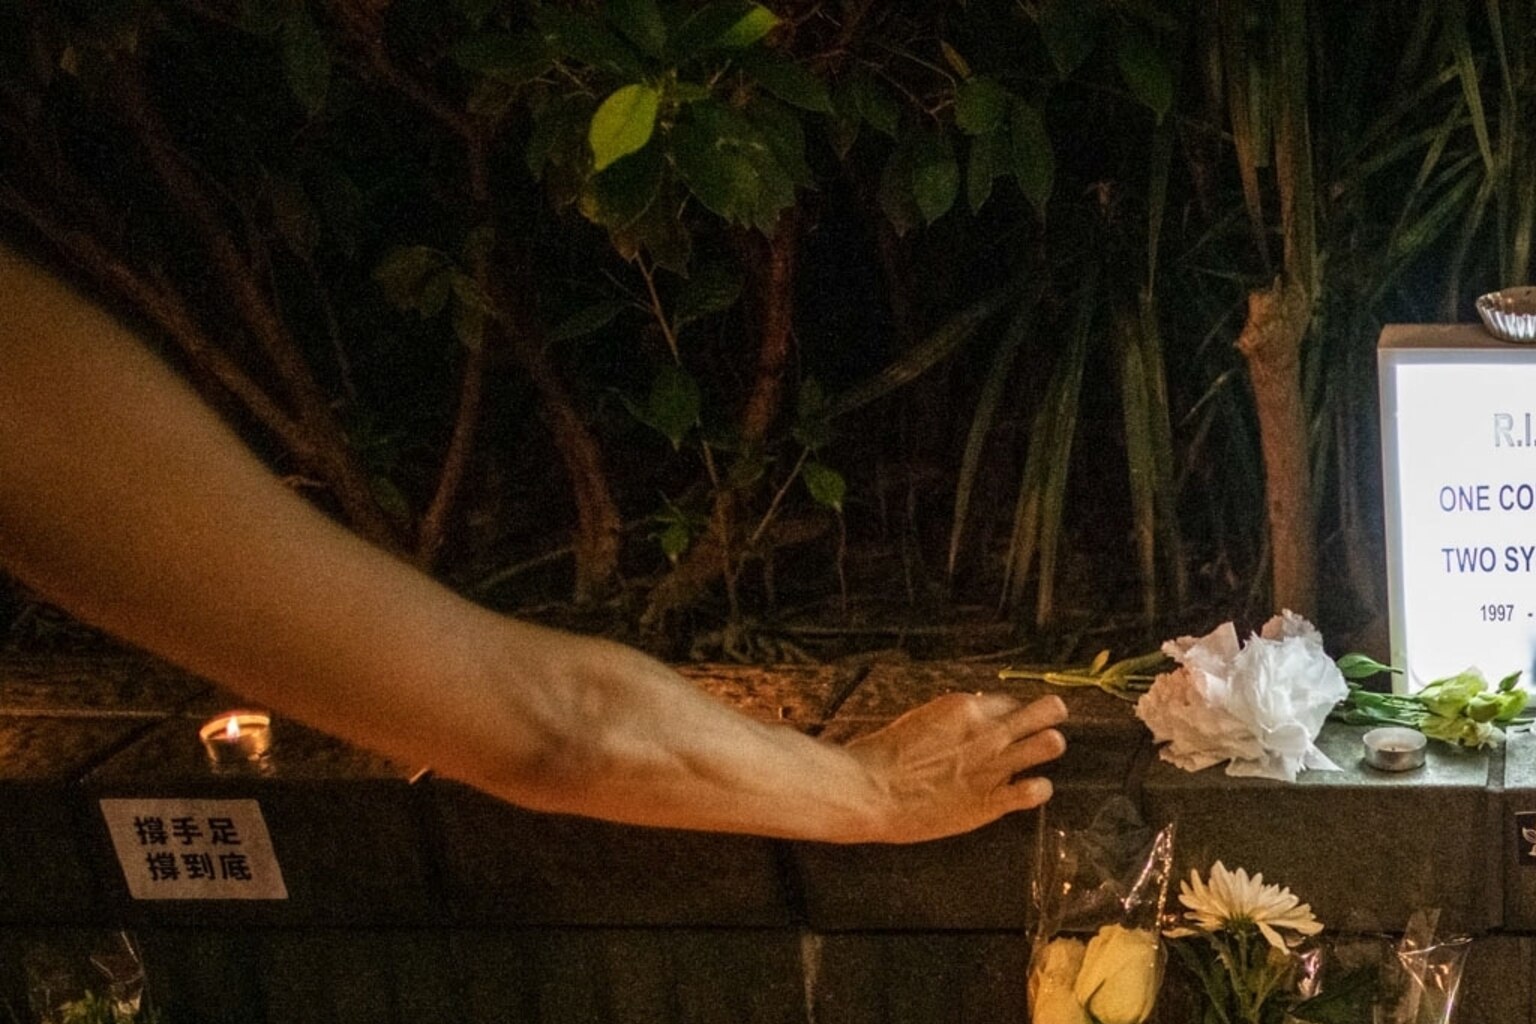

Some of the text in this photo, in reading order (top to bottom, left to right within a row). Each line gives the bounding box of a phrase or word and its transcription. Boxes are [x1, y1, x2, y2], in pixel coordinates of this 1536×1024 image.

[1439, 484, 1492, 513] ONE
[1440, 546, 1497, 574] TWO
[1479, 603, 1515, 622] 1997
